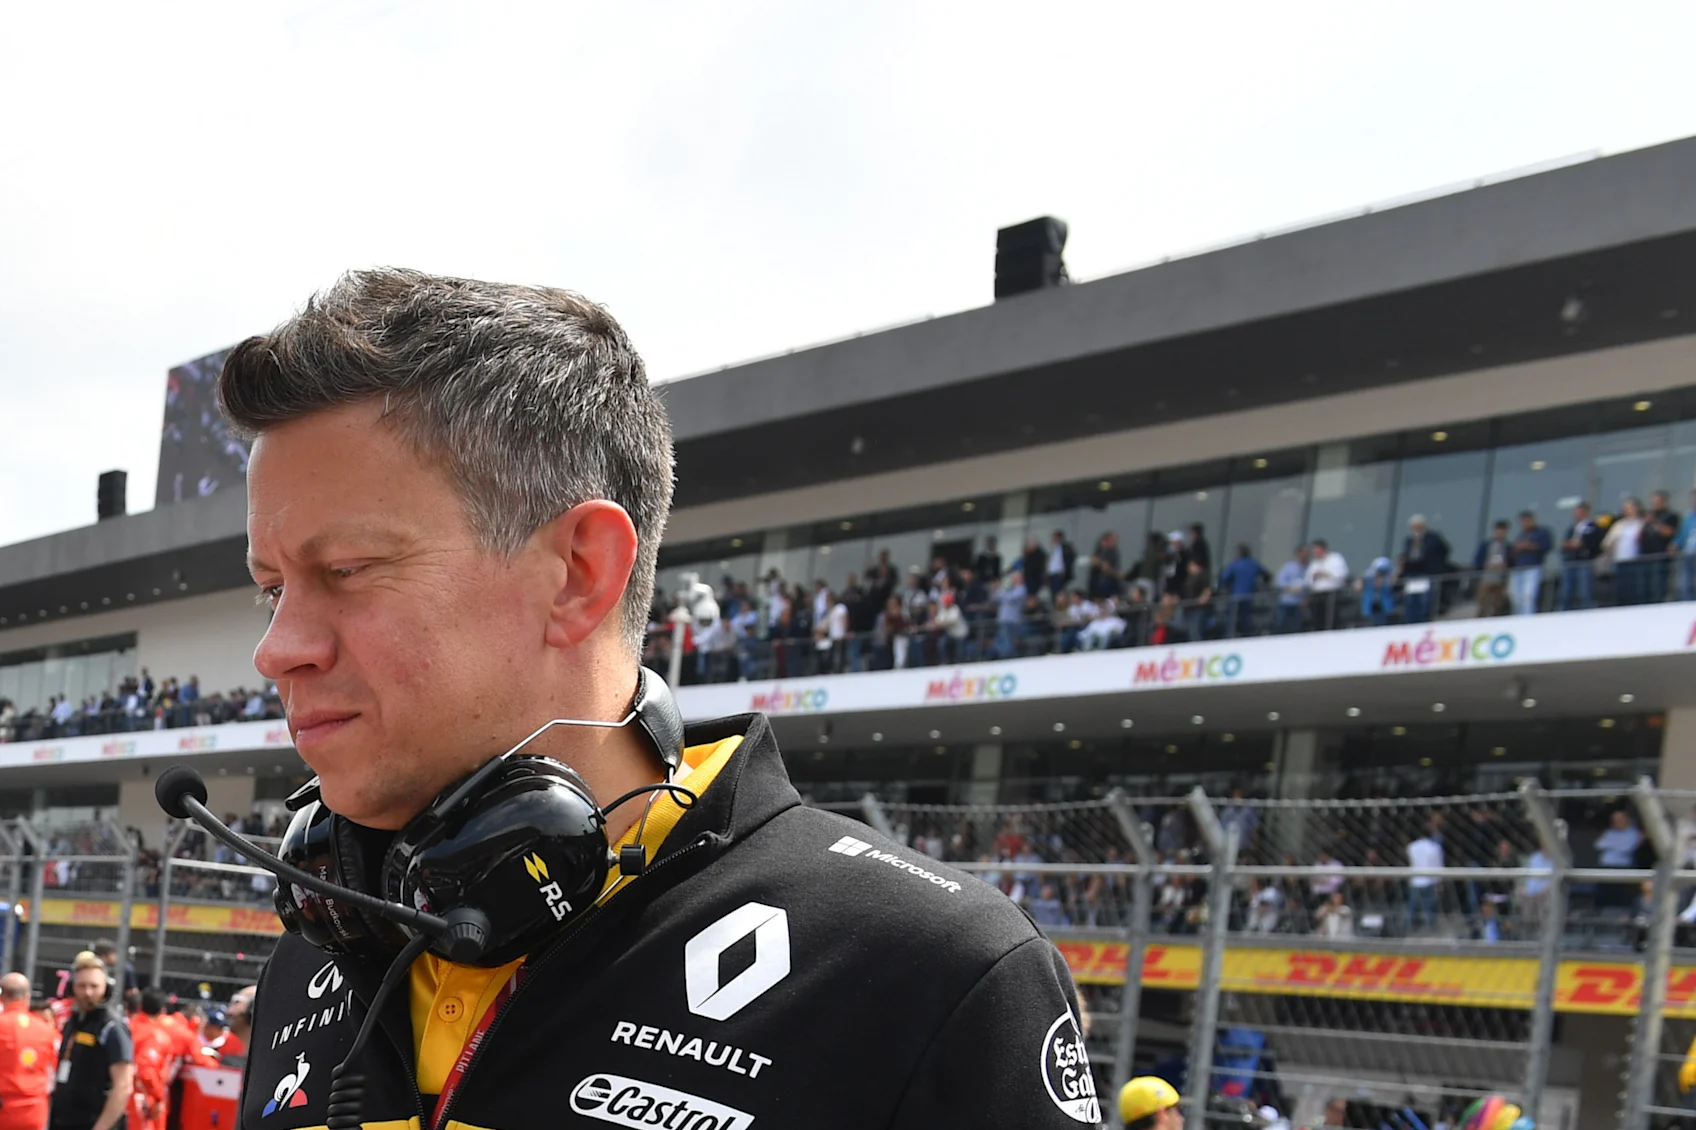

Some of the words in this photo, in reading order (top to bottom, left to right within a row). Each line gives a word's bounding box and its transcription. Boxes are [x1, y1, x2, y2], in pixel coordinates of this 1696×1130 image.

[865, 849, 962, 893] Microsoft
[539, 881, 573, 921] R.S.
[1286, 952, 1431, 990] DHL
[455, 1054, 471, 1074] PIT
[610, 1021, 772, 1079] RENAULT
